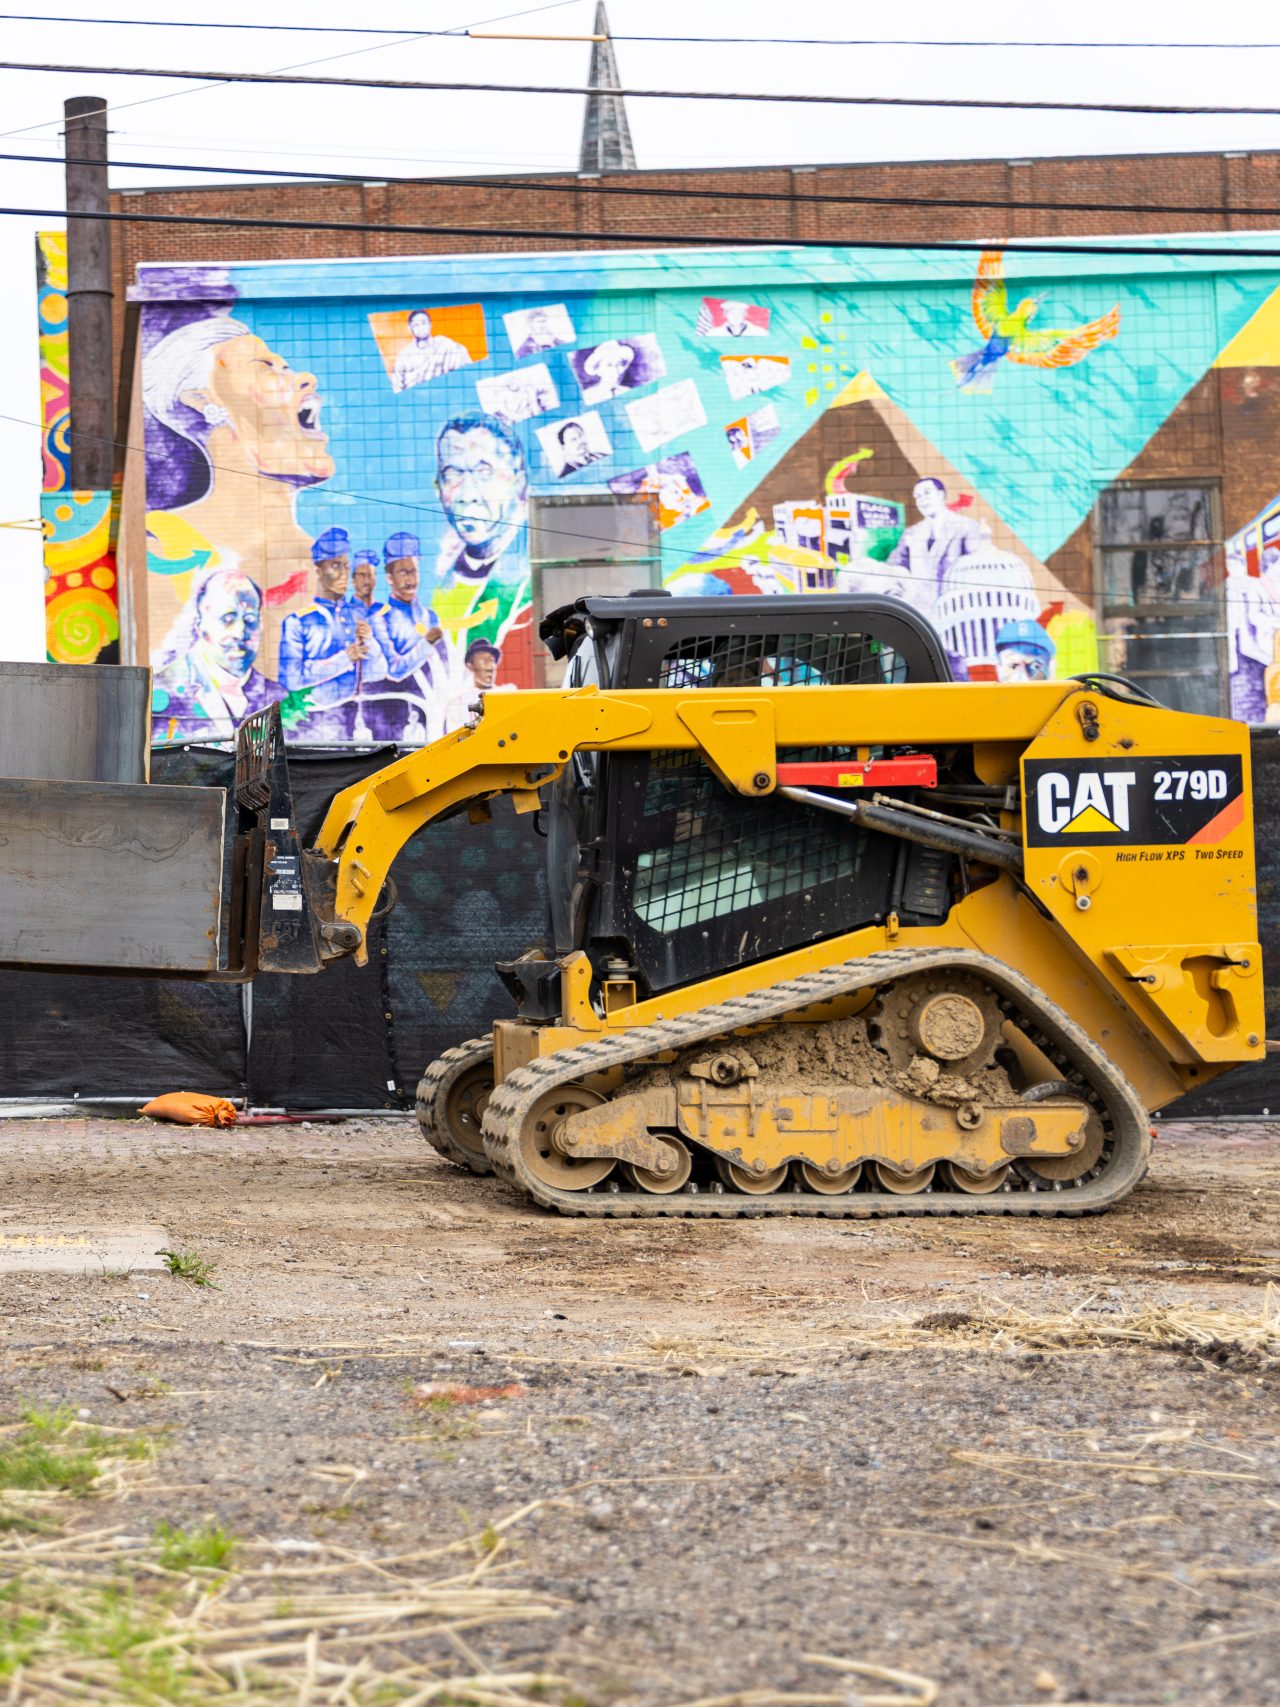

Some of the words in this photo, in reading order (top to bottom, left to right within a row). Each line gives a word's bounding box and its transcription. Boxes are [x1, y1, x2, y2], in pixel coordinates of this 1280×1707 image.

[1153, 770, 1228, 801] 279D
[1037, 771, 1136, 834] CAT
[1116, 851, 1137, 862] HIGH
[1139, 851, 1163, 862] FLOW
[1165, 850, 1186, 861] XPS
[1195, 849, 1214, 860] TWO
[1215, 849, 1244, 860] SPEED
